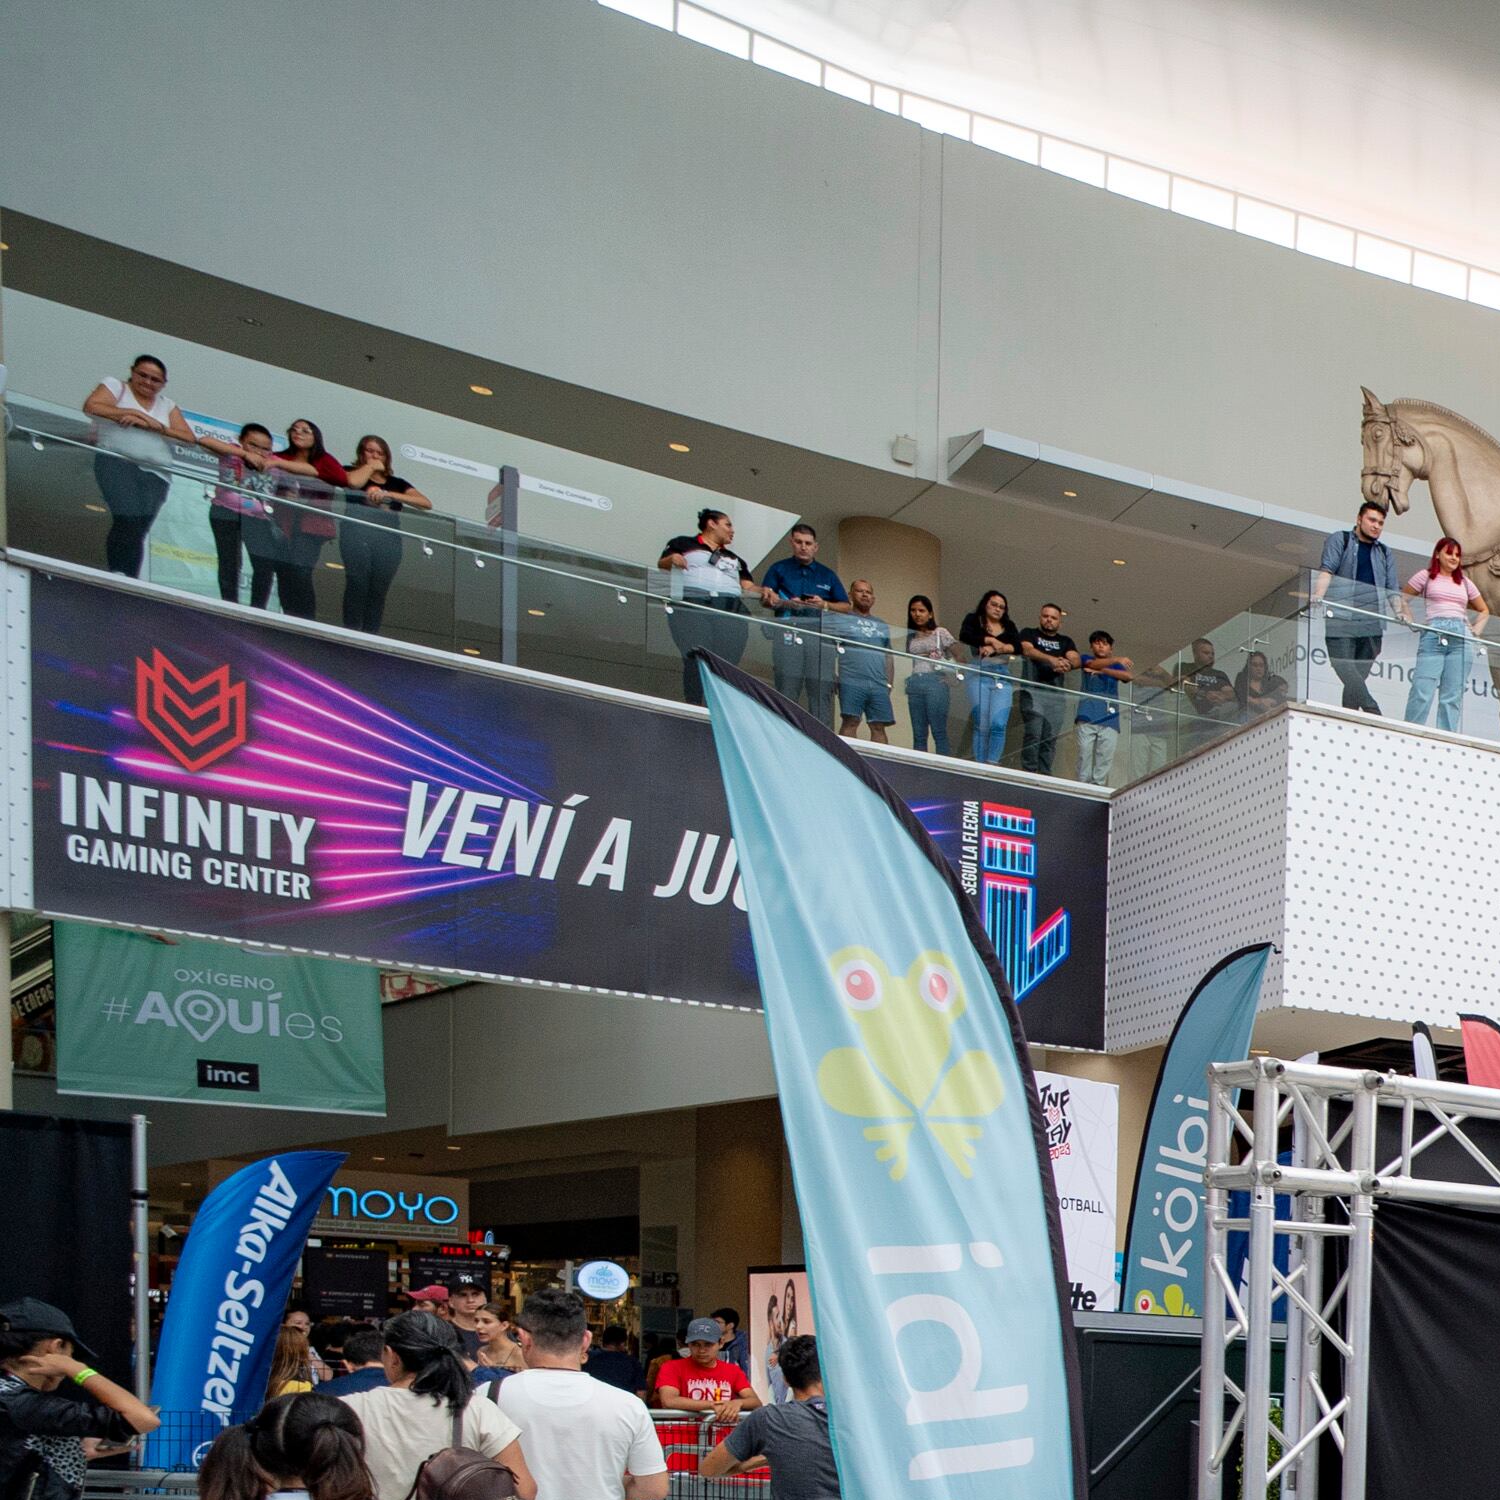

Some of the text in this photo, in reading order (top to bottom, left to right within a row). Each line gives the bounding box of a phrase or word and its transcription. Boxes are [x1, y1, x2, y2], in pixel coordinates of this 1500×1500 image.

[60, 771, 316, 866] INFINITY
[402, 780, 590, 881] VENÍ
[577, 816, 633, 892] A
[958, 800, 979, 896] SEGUÍ LA FLECHA
[67, 833, 312, 900] GAMING CENTER
[174, 968, 275, 992] OXÍGENO
[206, 1064, 250, 1085] imc
[1140, 1093, 1210, 1278] kölbi
[201, 1159, 299, 1427] Alka-Seltzer
